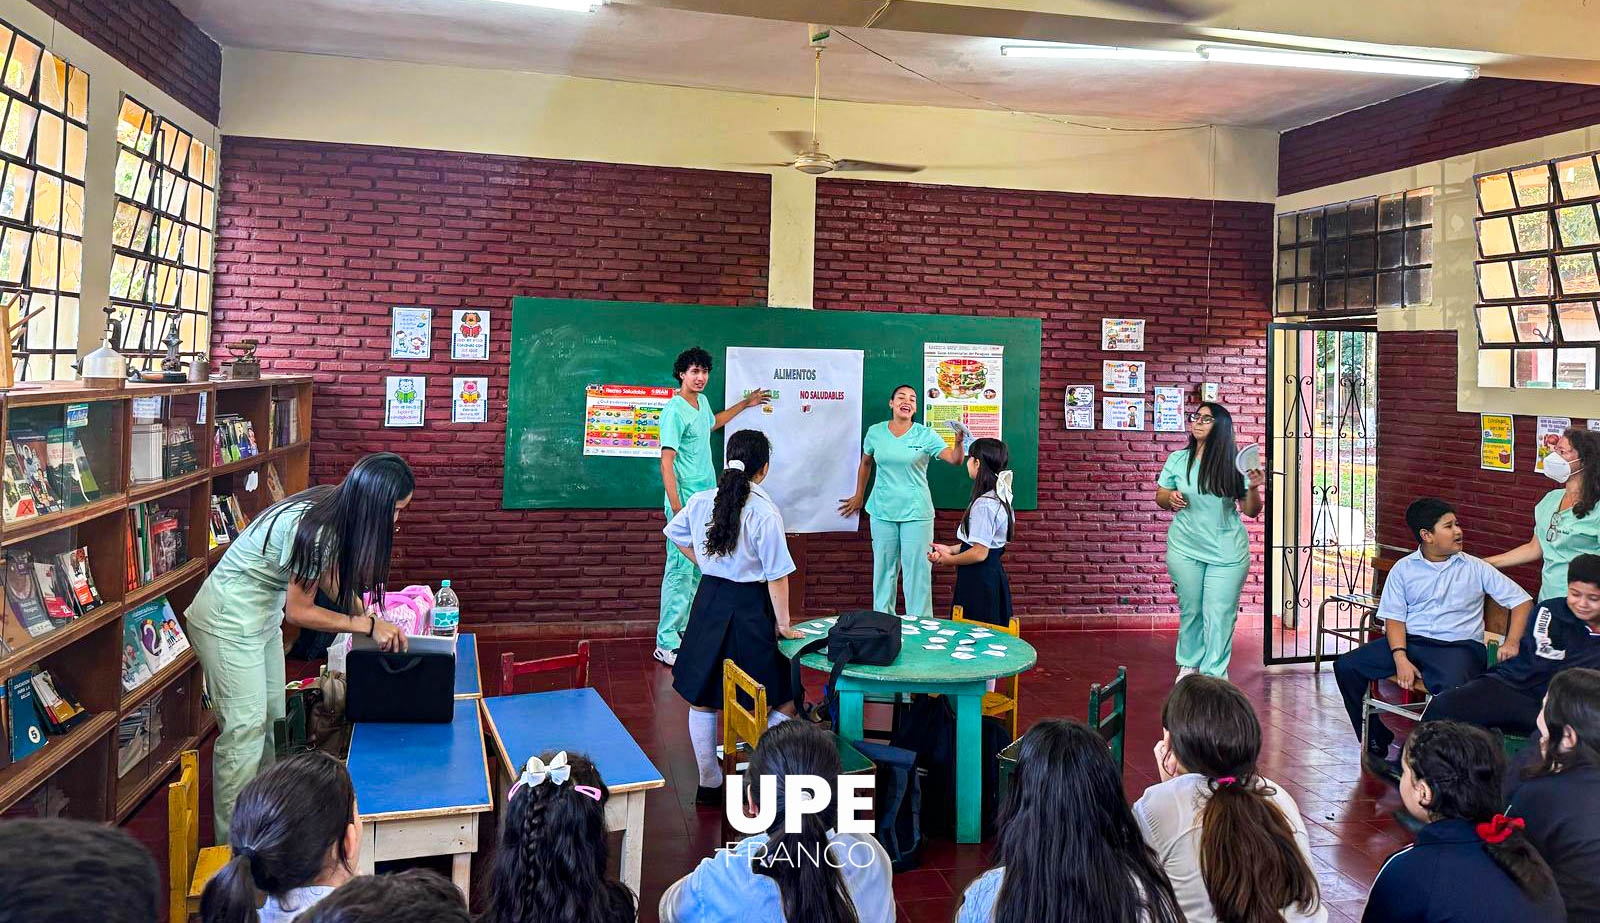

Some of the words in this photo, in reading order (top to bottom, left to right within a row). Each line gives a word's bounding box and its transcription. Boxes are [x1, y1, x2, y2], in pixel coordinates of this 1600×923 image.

[773, 368, 817, 381] ALIMENTOS
[800, 390, 809, 400] NO
[810, 390, 845, 400] SALUDABLES
